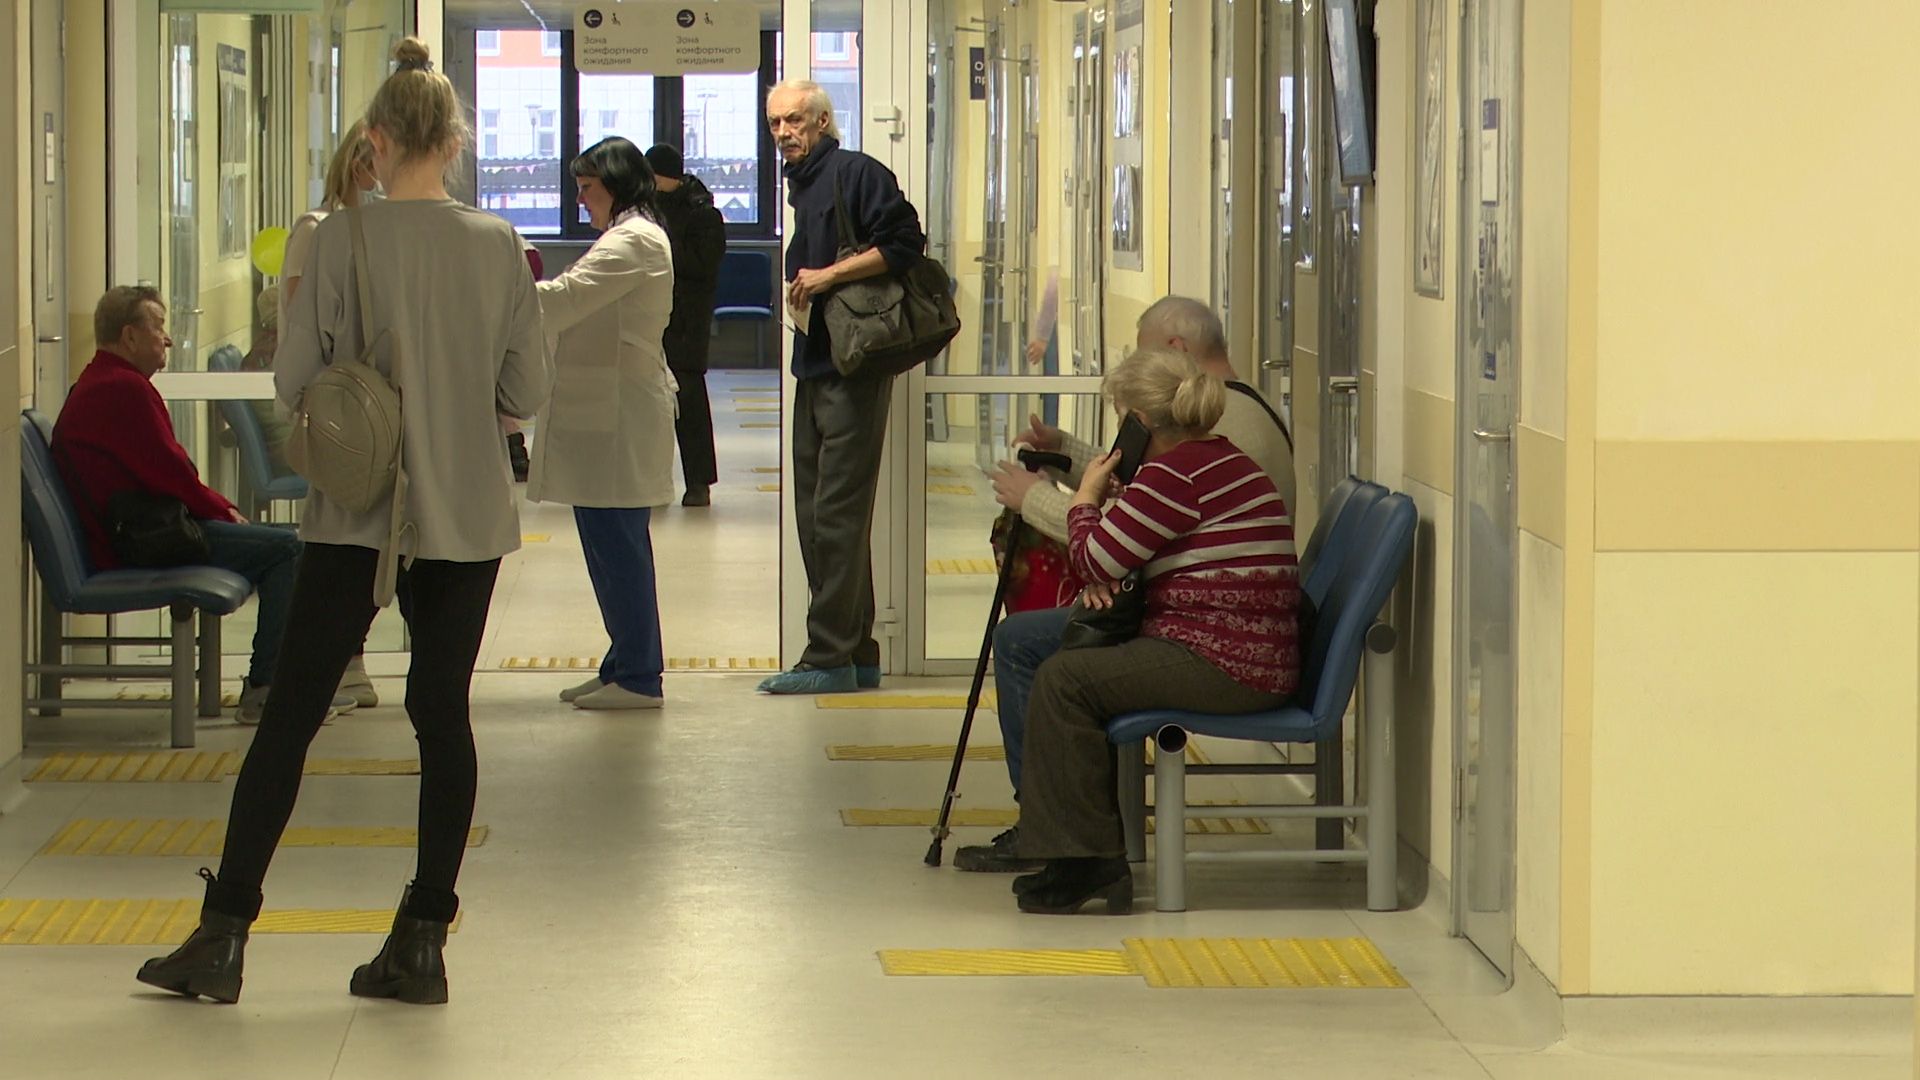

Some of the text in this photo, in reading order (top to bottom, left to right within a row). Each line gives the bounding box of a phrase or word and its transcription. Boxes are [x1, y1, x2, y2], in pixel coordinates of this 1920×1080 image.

[583, 36, 607, 45] Зона
[676, 36, 699, 44] Зона
[583, 47, 649, 56] комфортного
[676, 46, 742, 55] комфортного
